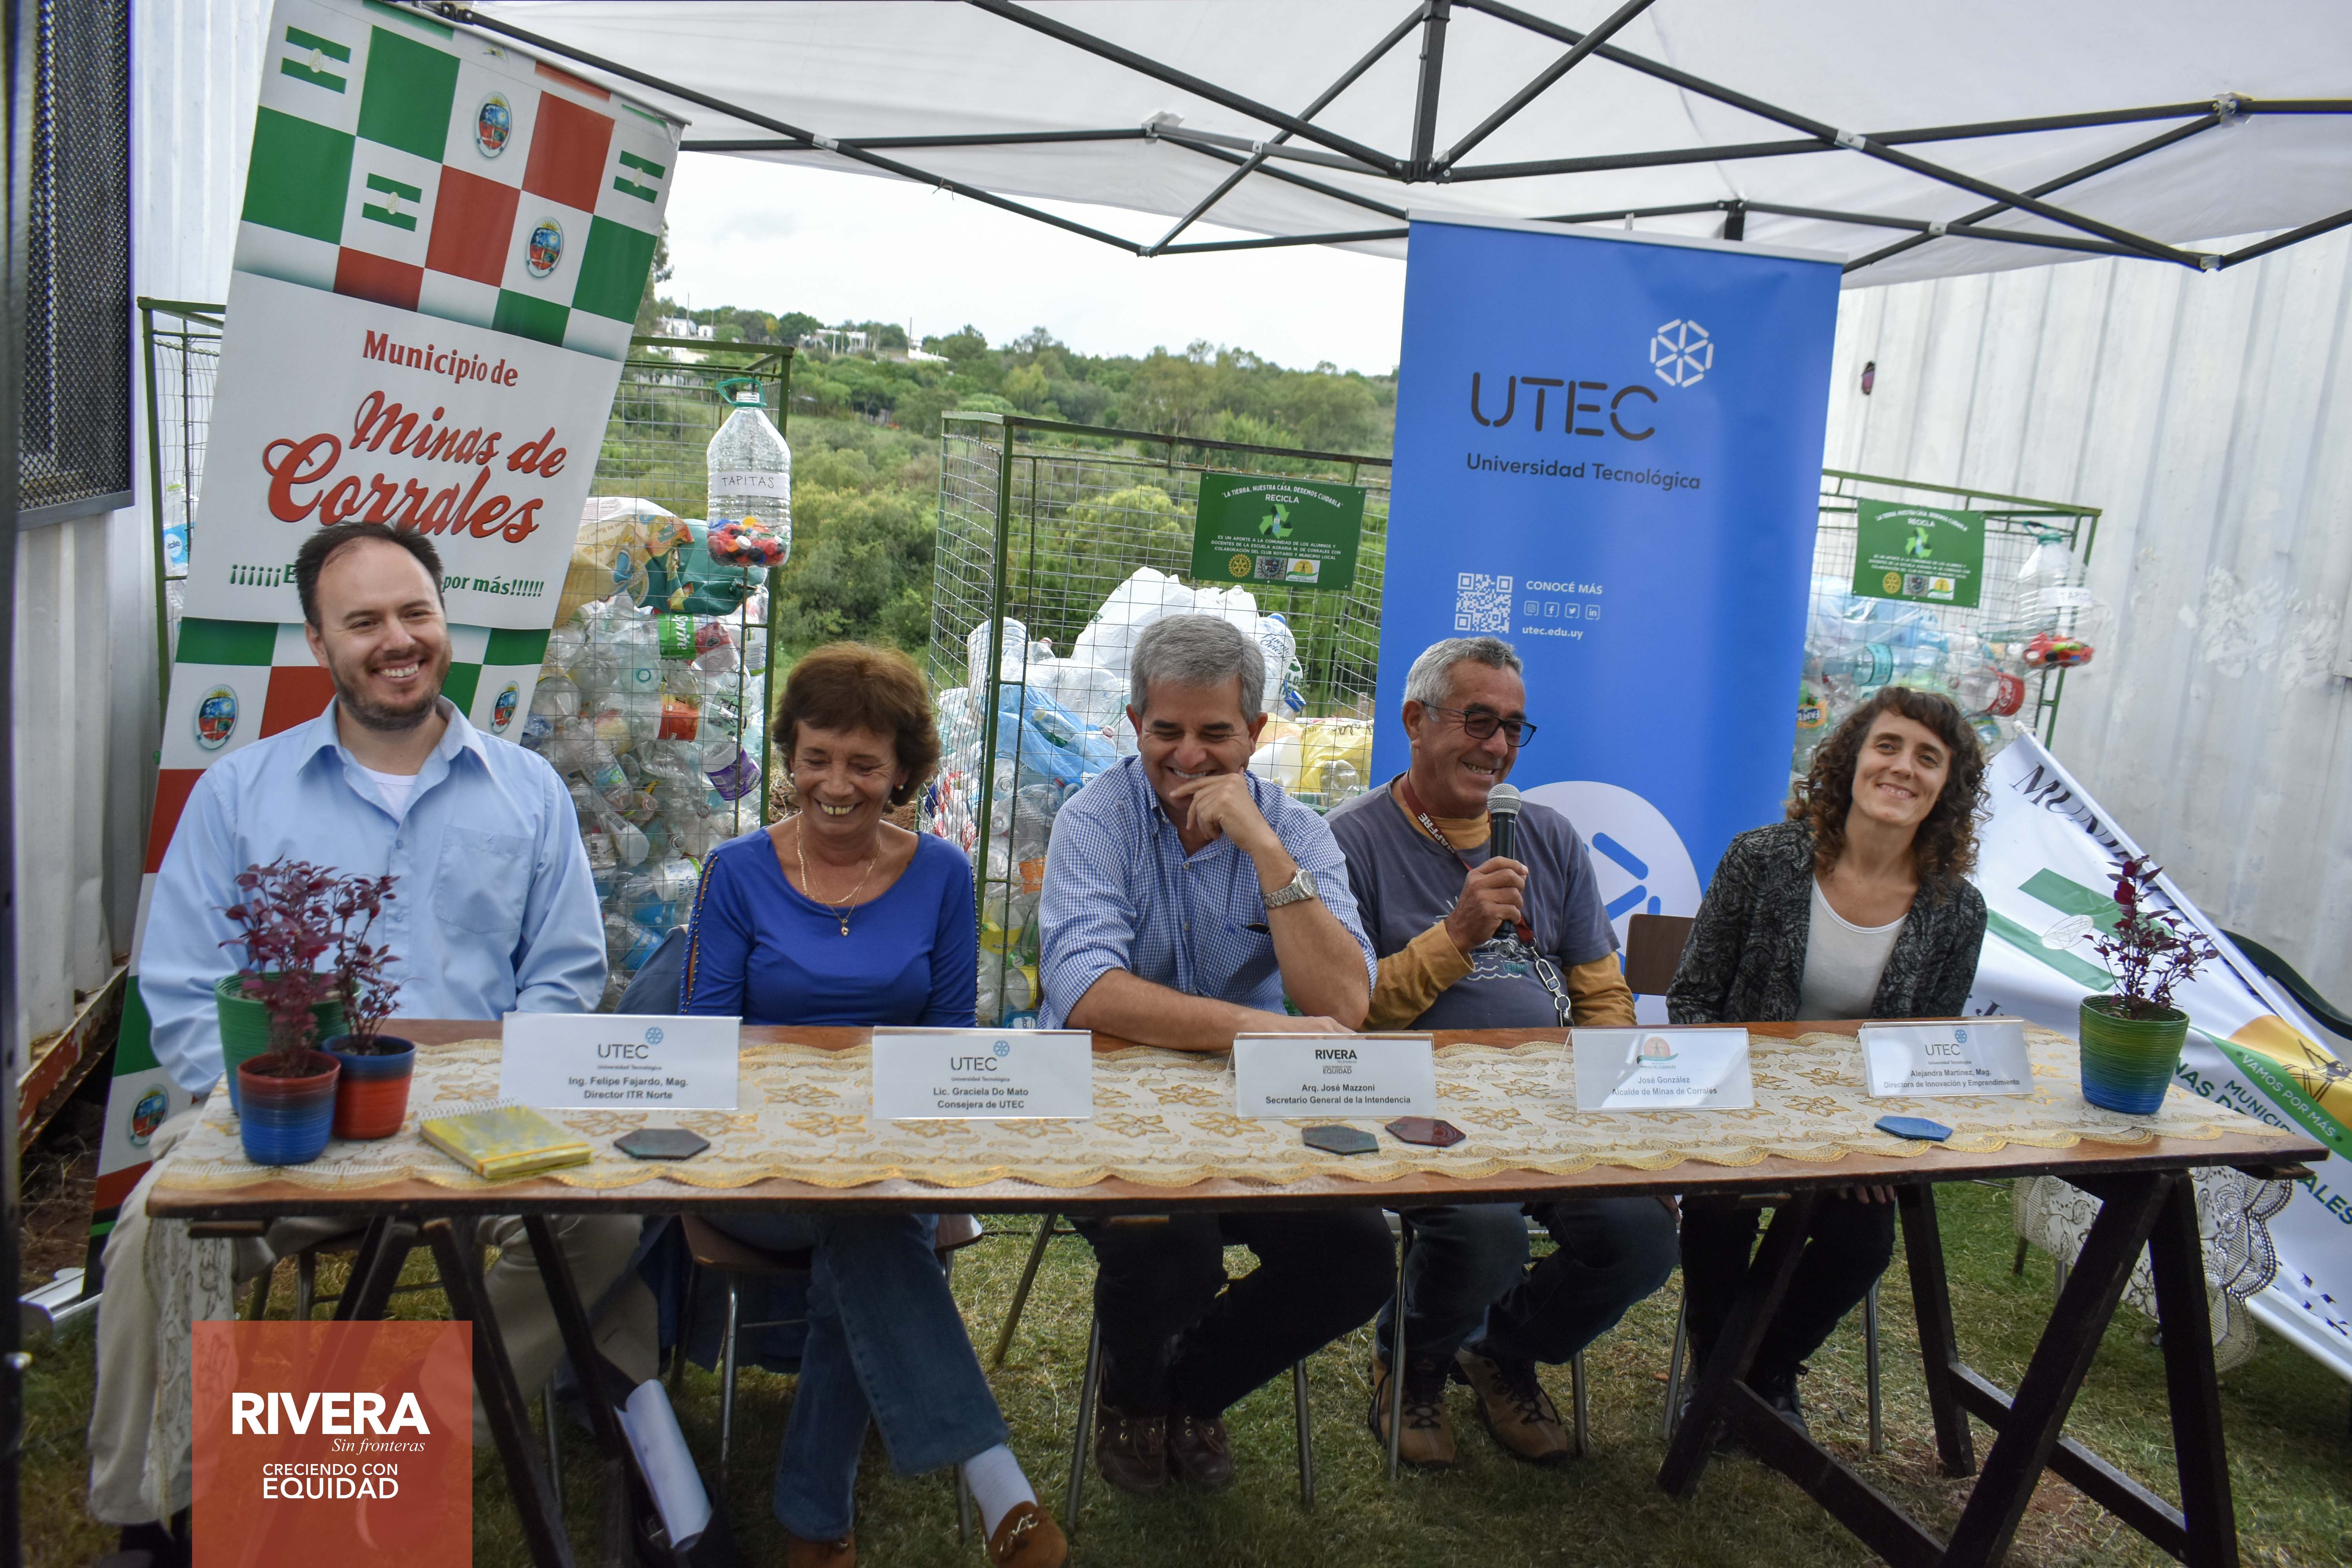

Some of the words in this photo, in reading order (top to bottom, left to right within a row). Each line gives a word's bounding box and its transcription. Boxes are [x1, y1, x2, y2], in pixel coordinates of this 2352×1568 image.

[363, 329, 489, 384] Municipio
[491, 361, 518, 387] de
[1470, 372, 1658, 441] UTEC
[349, 390, 502, 466] Minas
[507, 427, 567, 477] de
[1467, 453, 1585, 479] Universidad
[1592, 463, 1700, 491] Tecnológica
[262, 433, 544, 544] Corrales
[721, 476, 774, 489] TAPITAS
[1294, 486, 1318, 497] DEBEMOS
[1265, 494, 1299, 504] RECICLA
[442, 576, 470, 593] por
[472, 575, 544, 597] más!!!!!!
[1526, 580, 1575, 592] CONOCÉ
[1579, 583, 1602, 595] MÁS
[671, 614, 691, 650] Sprite
[1522, 626, 1583, 640] utec.edu.uy
[598, 1044, 649, 1059] UTEC
[1315, 1049, 1357, 1059] RIVERA
[1925, 1044, 1960, 1056] UTEC
[951, 1057, 997, 1071] UTEC
[1911, 1070, 1942, 1078] Alejandra
[1976, 1069, 1991, 1077] Mag.
[568, 1077, 587, 1087] Ing.
[591, 1077, 620, 1087] Felipe
[623, 1077, 663, 1087] Fajardo,
[666, 1078, 688, 1087] Mag.
[1638, 1076, 1655, 1084] José
[1968, 1079, 2020, 1087] Emprendimiento
[584, 1090, 624, 1099] Director
[626, 1091, 643, 1099] ITR
[646, 1091, 673, 1099] Norte
[933, 1087, 949, 1096] Lic.
[952, 1087, 989, 1096] Graciela
[992, 1088, 1005, 1096] Do
[1007, 1088, 1029, 1096] Mato
[1301, 1084, 1319, 1093] Arq.
[1265, 1096, 1307, 1104] Secretario
[1309, 1096, 1341, 1104] General
[1343, 1096, 1354, 1104] de
[1356, 1096, 1363, 1104] la
[1365, 1096, 1411, 1104] Intendencia
[2242, 1055, 2284, 1092] VAMOS
[2282, 1090, 2309, 1114] POR
[2307, 1111, 2336, 1137] MÁS
[937, 1100, 983, 1110] Consejera
[999, 1100, 1024, 1109] UTEC
